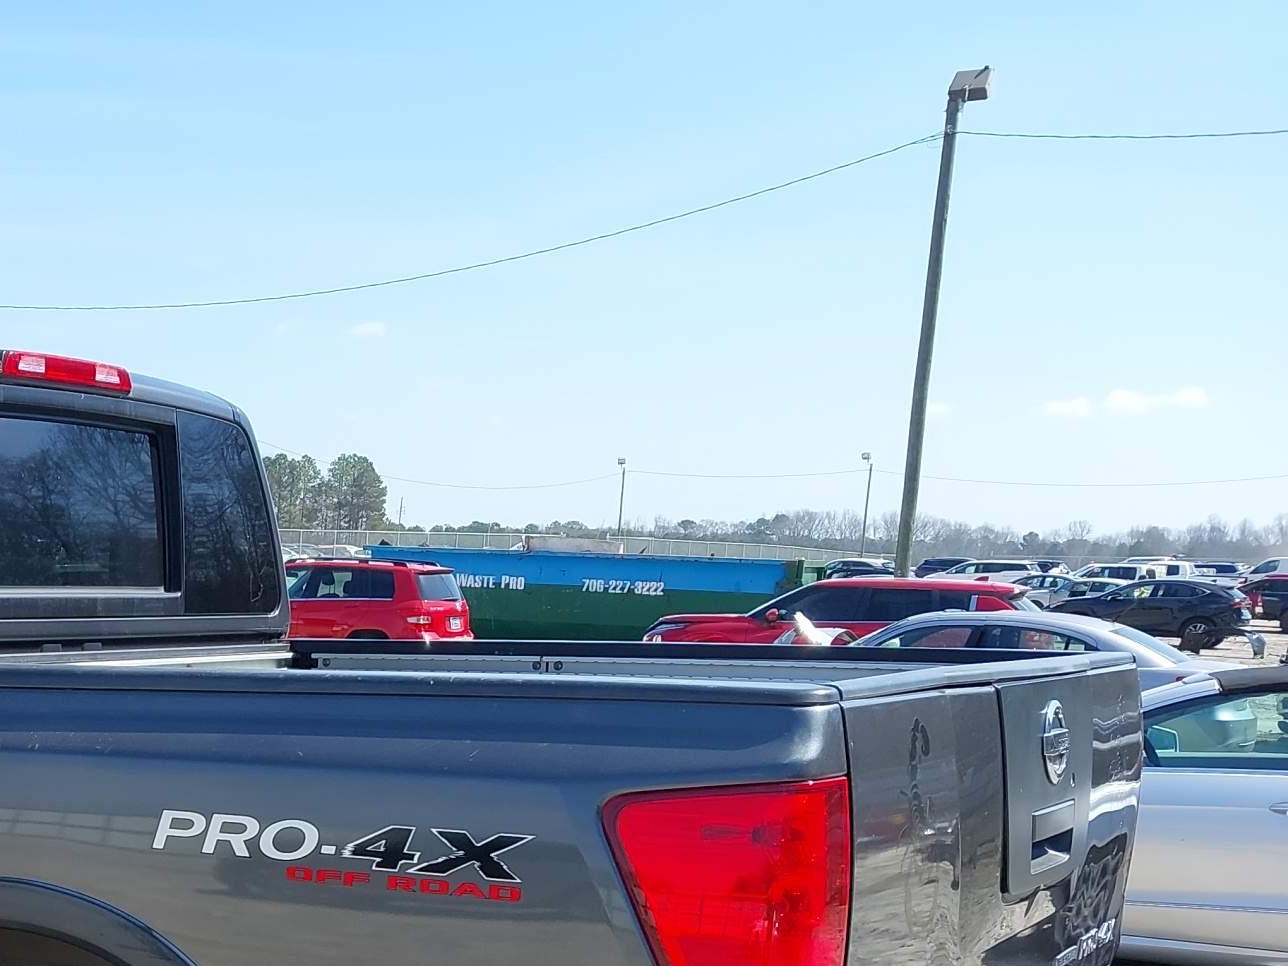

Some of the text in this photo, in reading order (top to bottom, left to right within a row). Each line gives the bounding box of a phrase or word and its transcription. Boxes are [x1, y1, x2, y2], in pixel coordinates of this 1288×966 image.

[456, 573, 526, 591] WASTE PRO
[581, 578, 666, 596] 706-227-3222
[152, 808, 537, 883] PRO-4X
[285, 865, 523, 903] OFF ROAD
